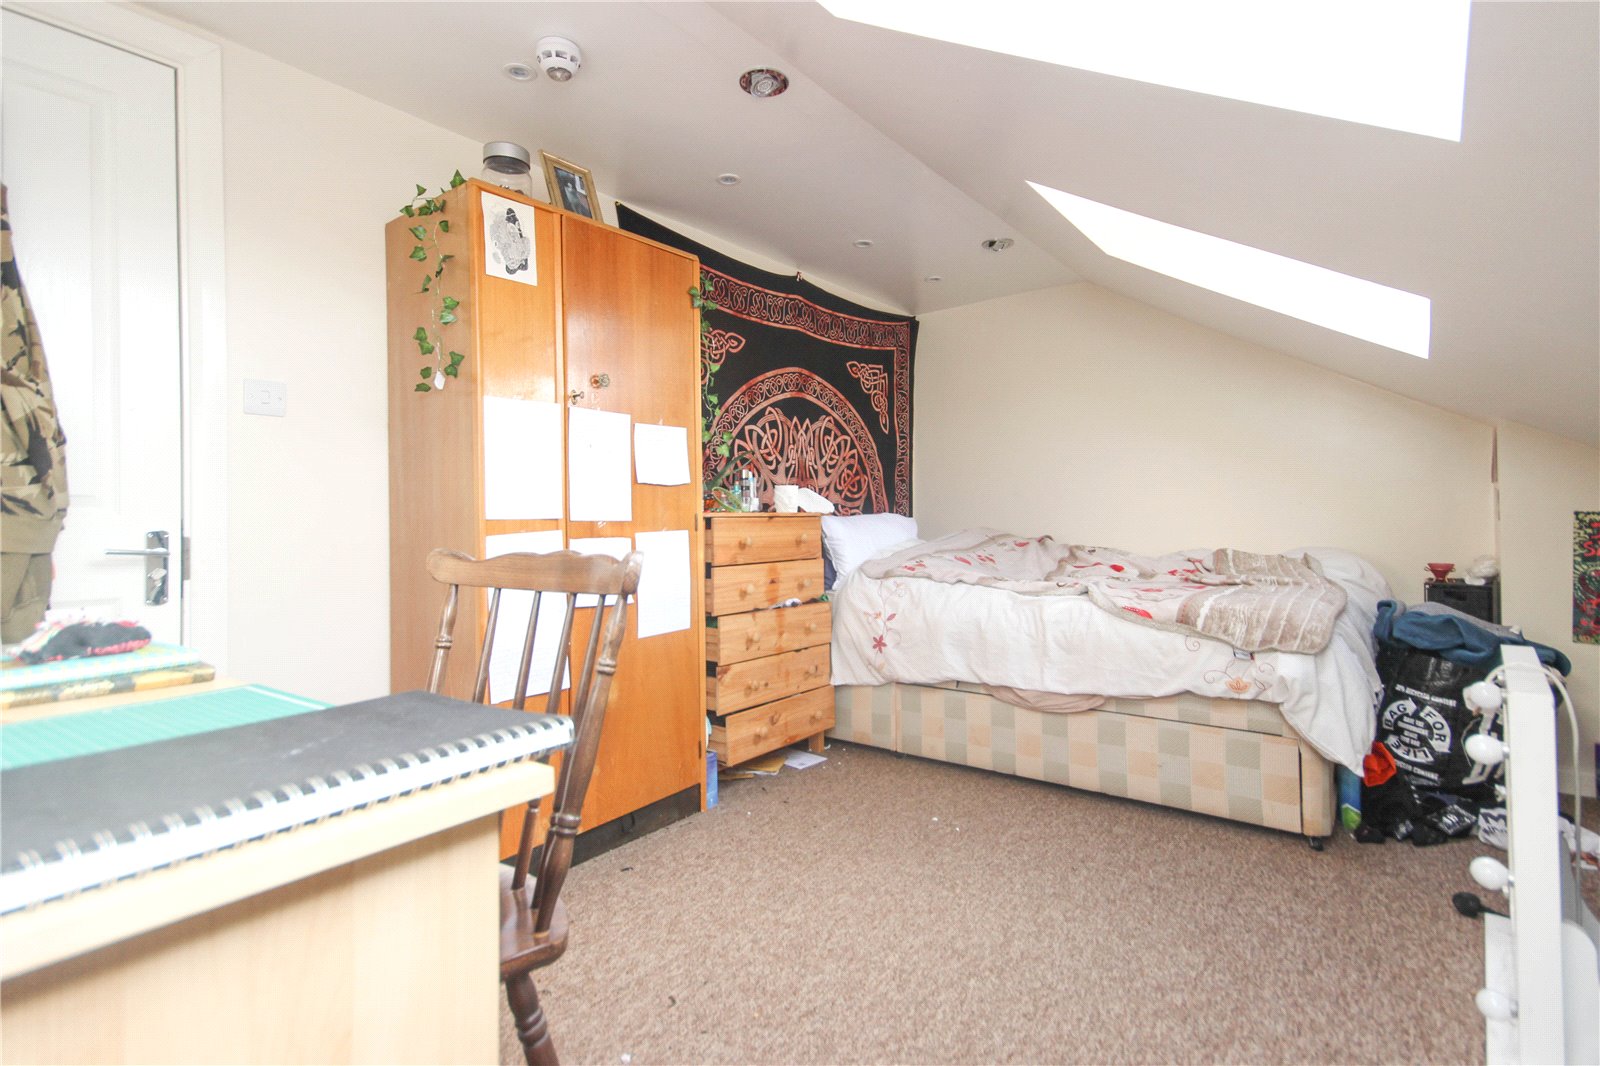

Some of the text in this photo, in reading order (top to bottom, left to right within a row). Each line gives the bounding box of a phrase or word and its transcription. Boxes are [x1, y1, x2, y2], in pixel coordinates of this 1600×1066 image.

[1384, 703, 1407, 728] BAG
[1424, 709, 1448, 743] FOR
[1391, 739, 1430, 760] LIFE
